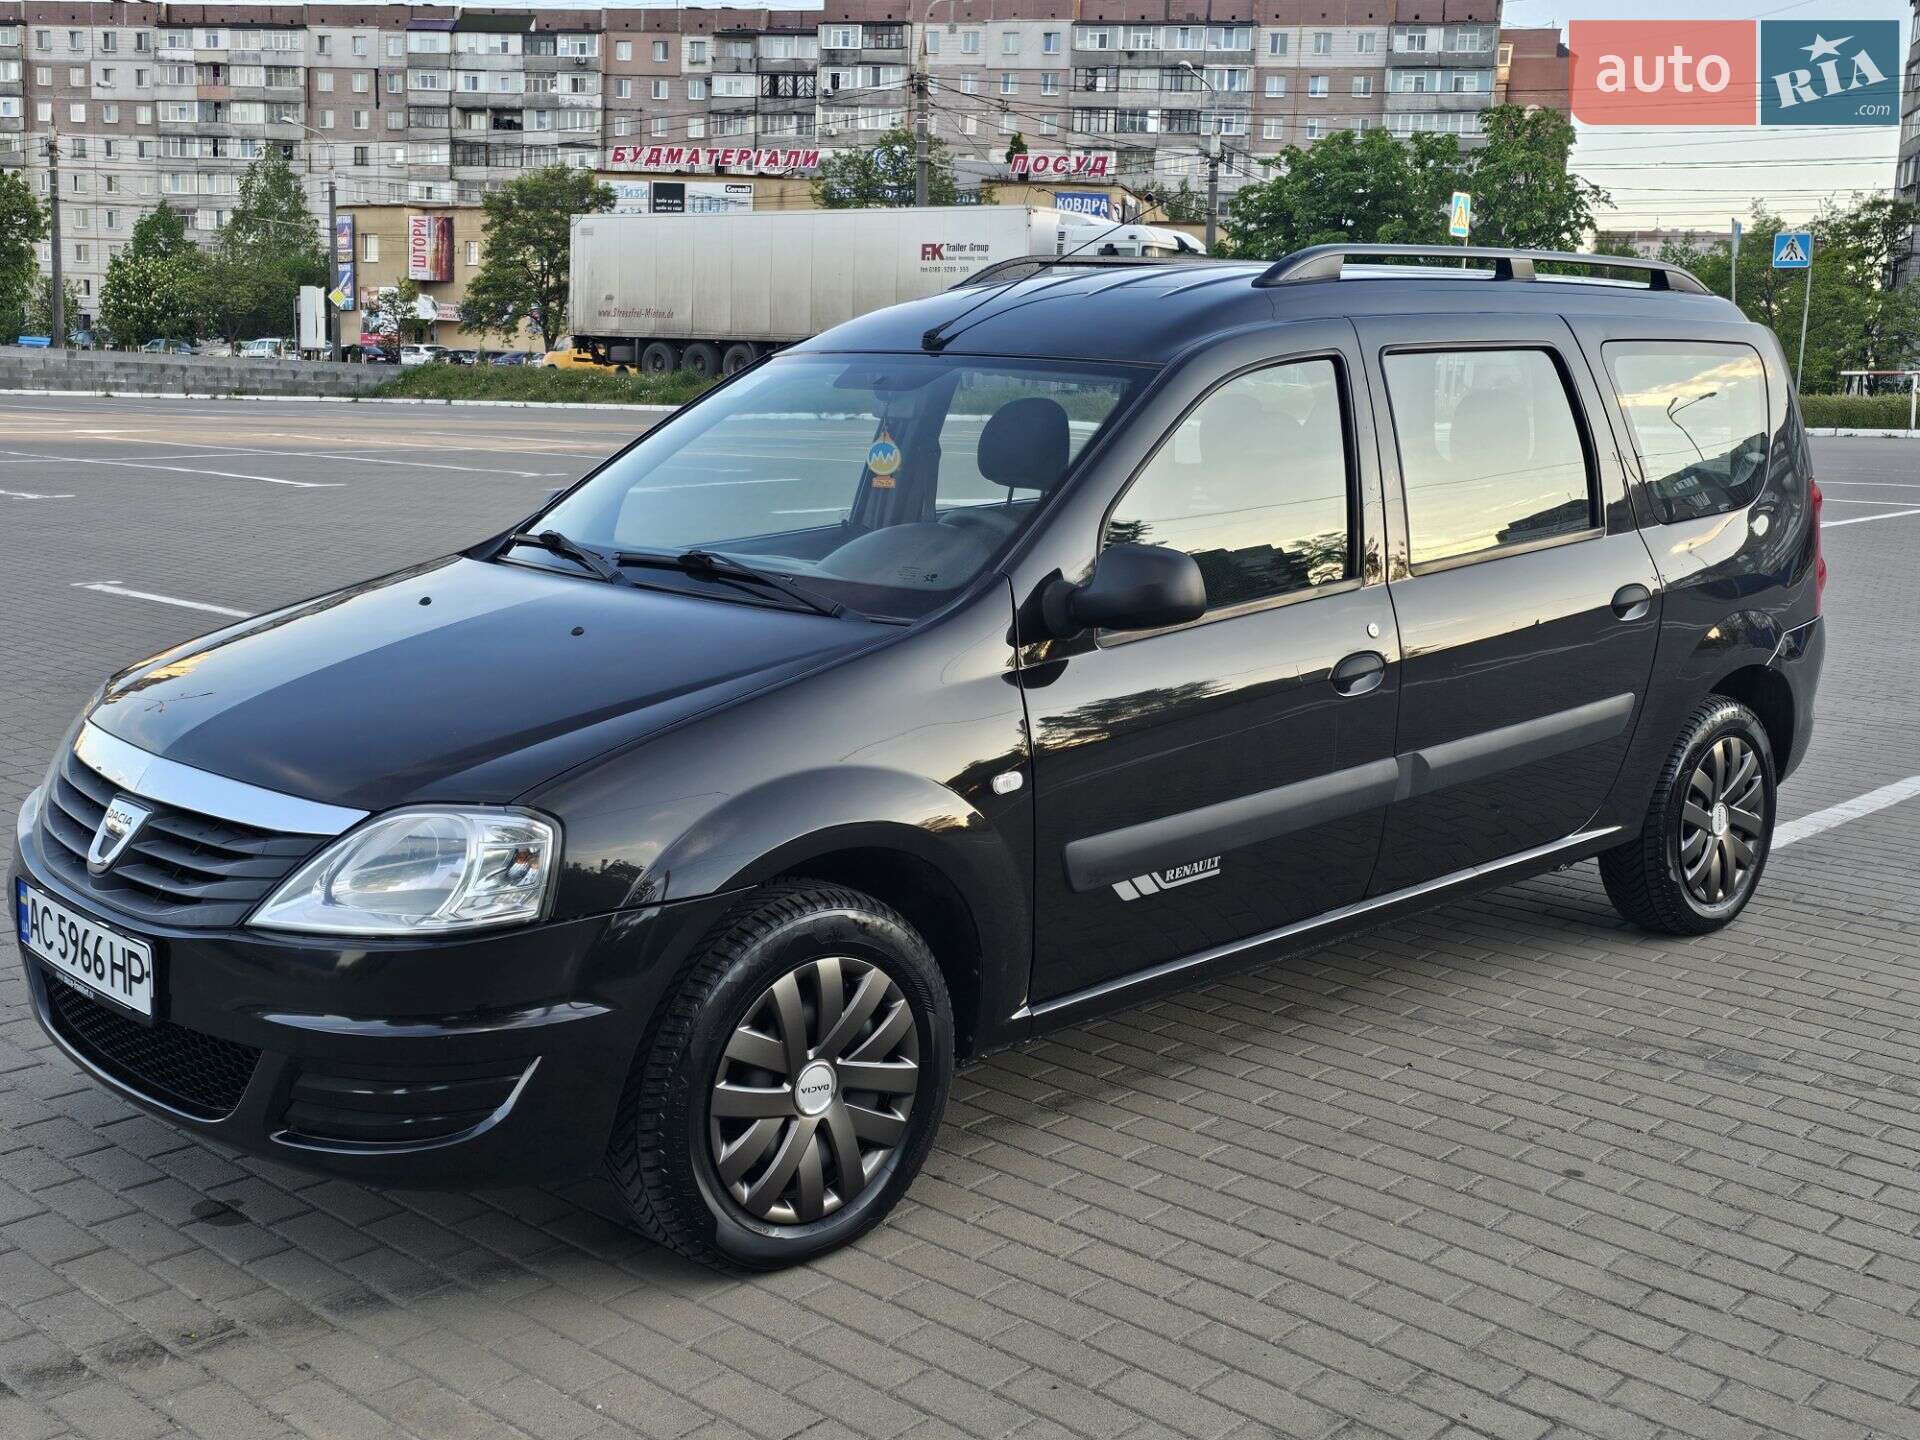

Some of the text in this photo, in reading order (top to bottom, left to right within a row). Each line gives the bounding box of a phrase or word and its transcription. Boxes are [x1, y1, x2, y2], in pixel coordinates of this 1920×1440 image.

[611, 146, 820, 168] БУДМАТЕРІАЛИ
[1009, 154, 1109, 177] ПОСУД
[1056, 197, 1108, 214] КОВДРА
[412, 219, 427, 268] ШТОРИ
[945, 243, 967, 252] Trailer
[969, 243, 989, 253] Group
[106, 808, 133, 825] DACIA
[1165, 856, 1221, 881] RENAULT
[30, 897, 54, 950] AC
[57, 913, 105, 981] 5966
[109, 940, 145, 996] HP
[801, 1084, 830, 1094] DACIA
